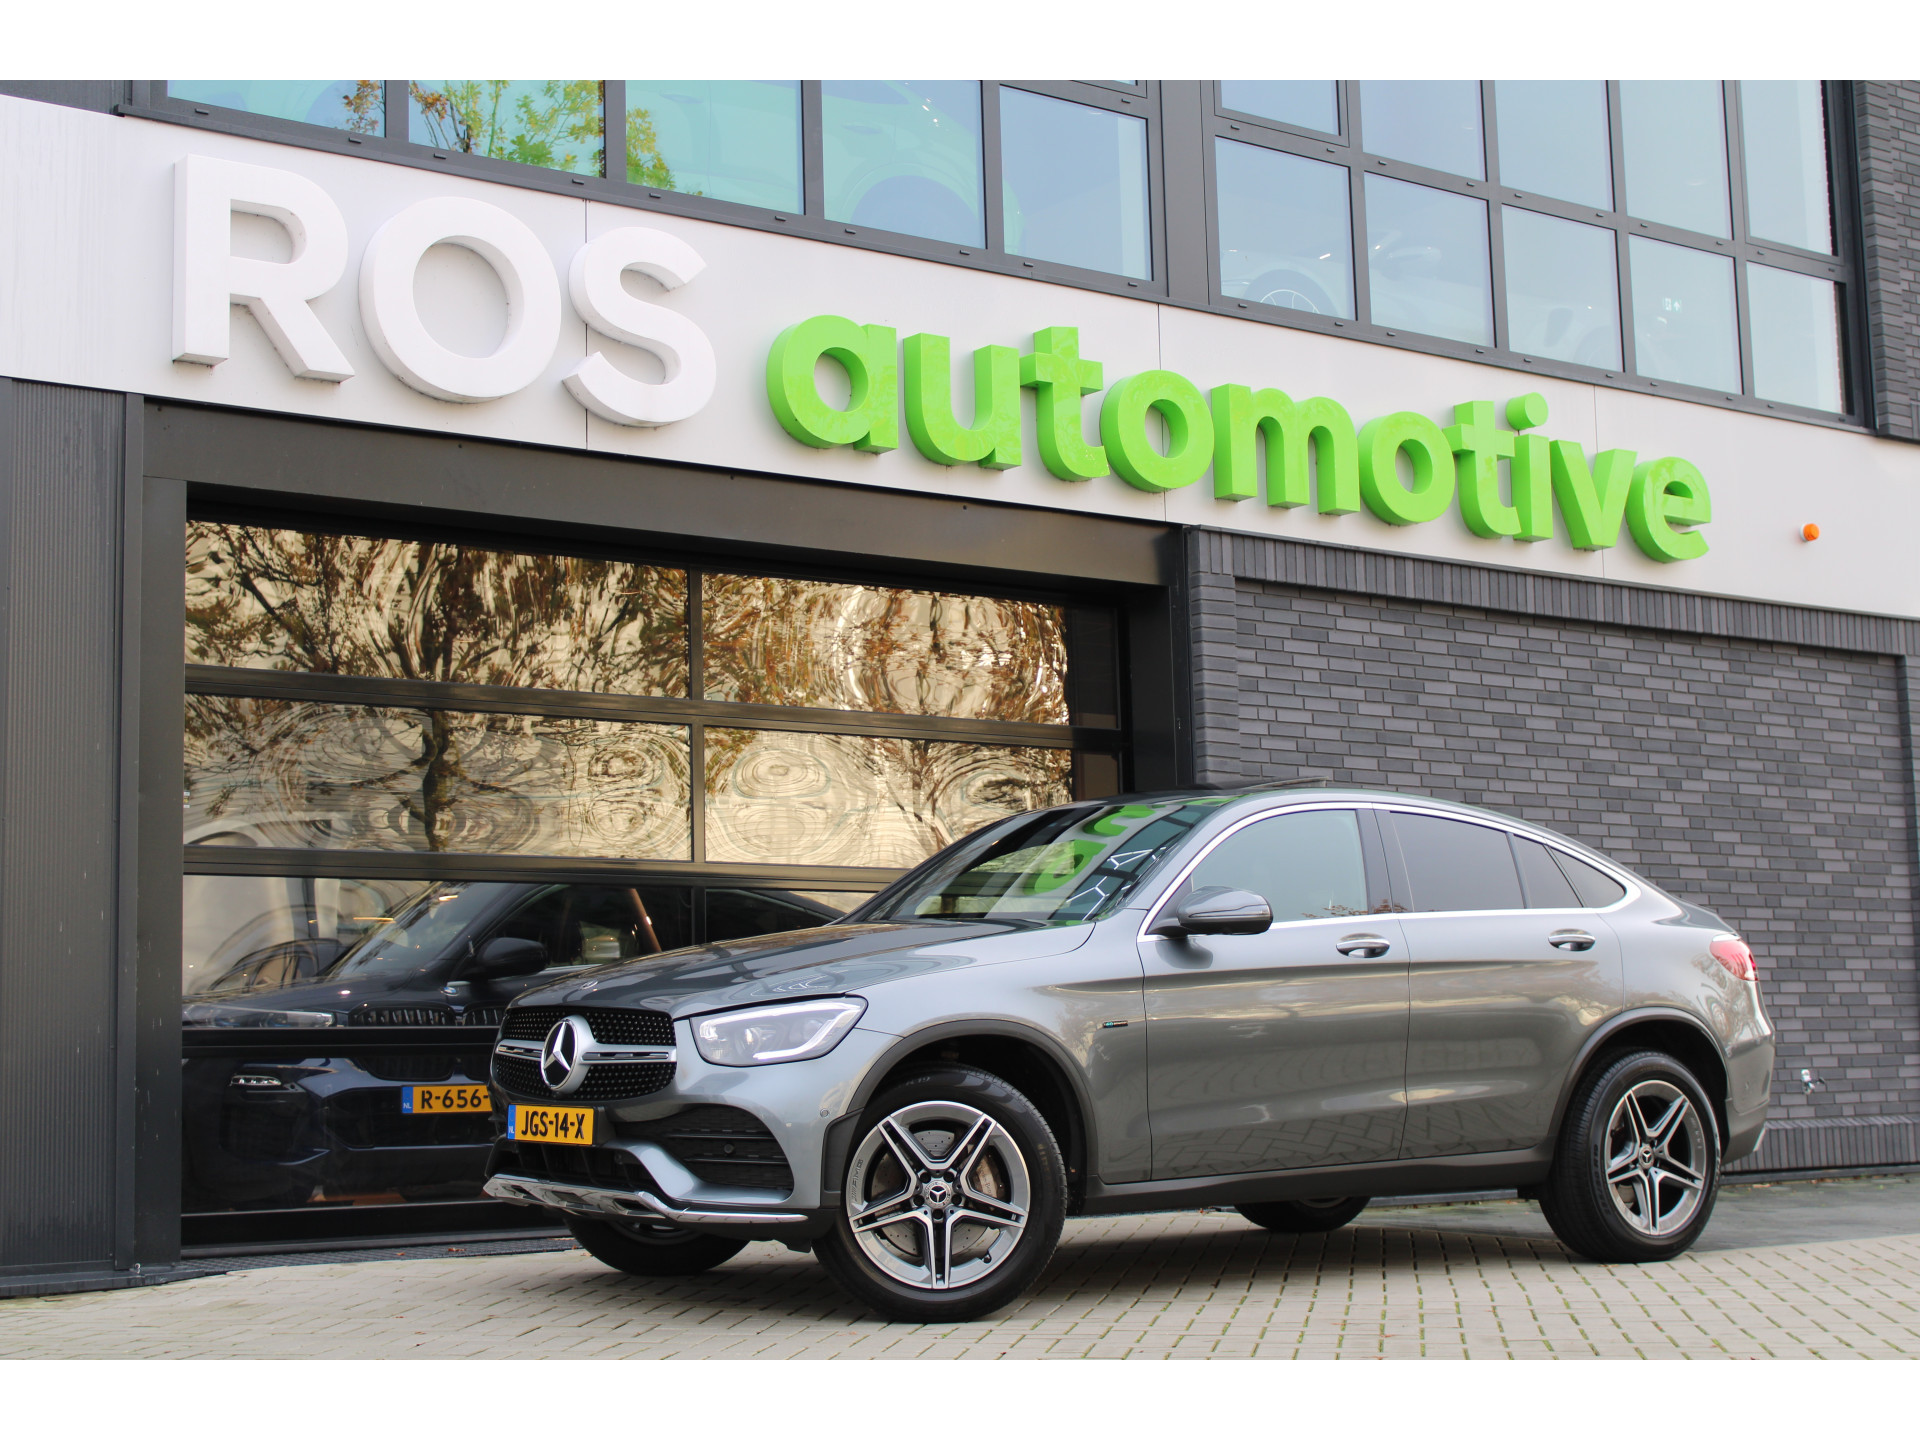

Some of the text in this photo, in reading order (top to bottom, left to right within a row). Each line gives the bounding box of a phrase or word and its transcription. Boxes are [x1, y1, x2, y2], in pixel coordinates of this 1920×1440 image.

[172, 154, 1712, 563] ROS automotive
[508, 1110, 585, 1139] NL JGS-14-X
